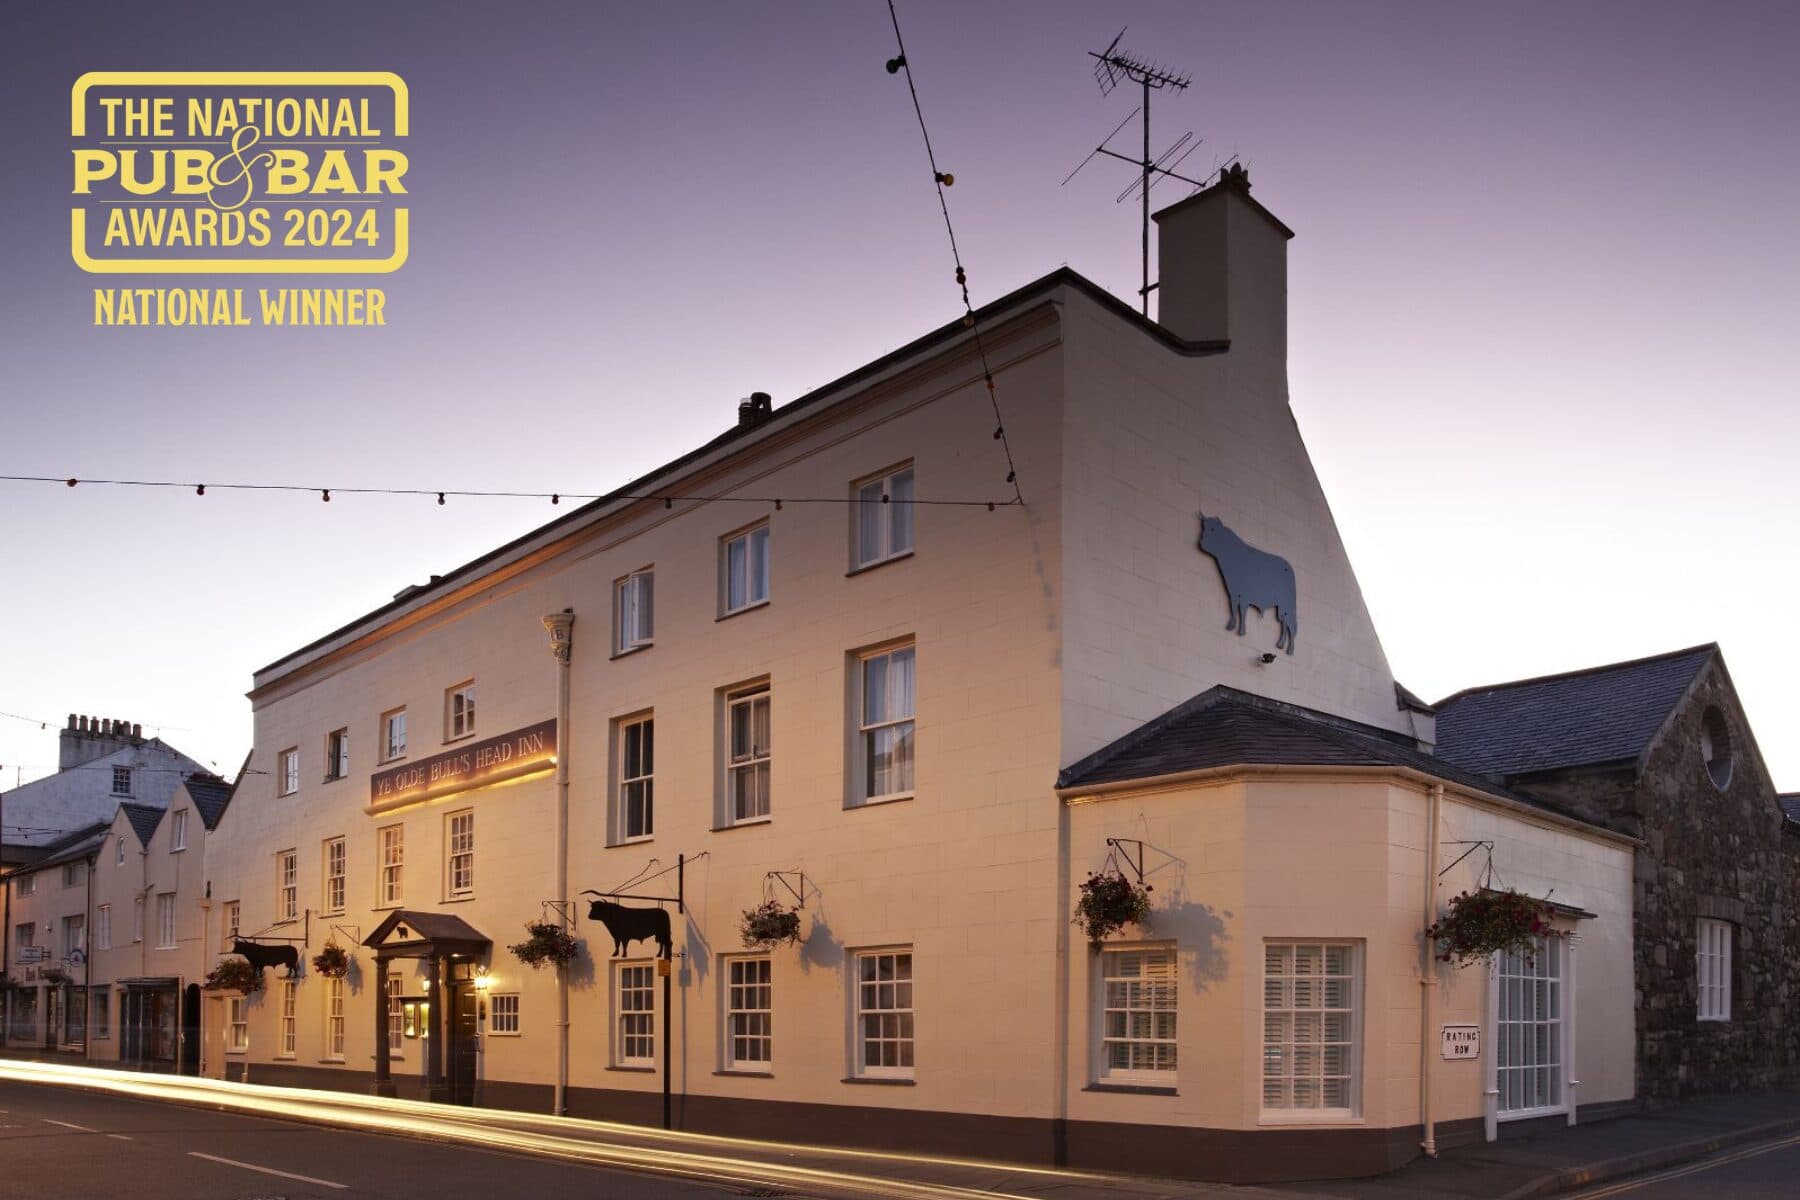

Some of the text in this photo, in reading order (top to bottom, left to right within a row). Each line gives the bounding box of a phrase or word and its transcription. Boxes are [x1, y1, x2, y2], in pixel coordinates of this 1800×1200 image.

[377, 731, 543, 796] YE OLDE BULL'S HEAD INN
[1454, 1045, 1469, 1054] ROW
